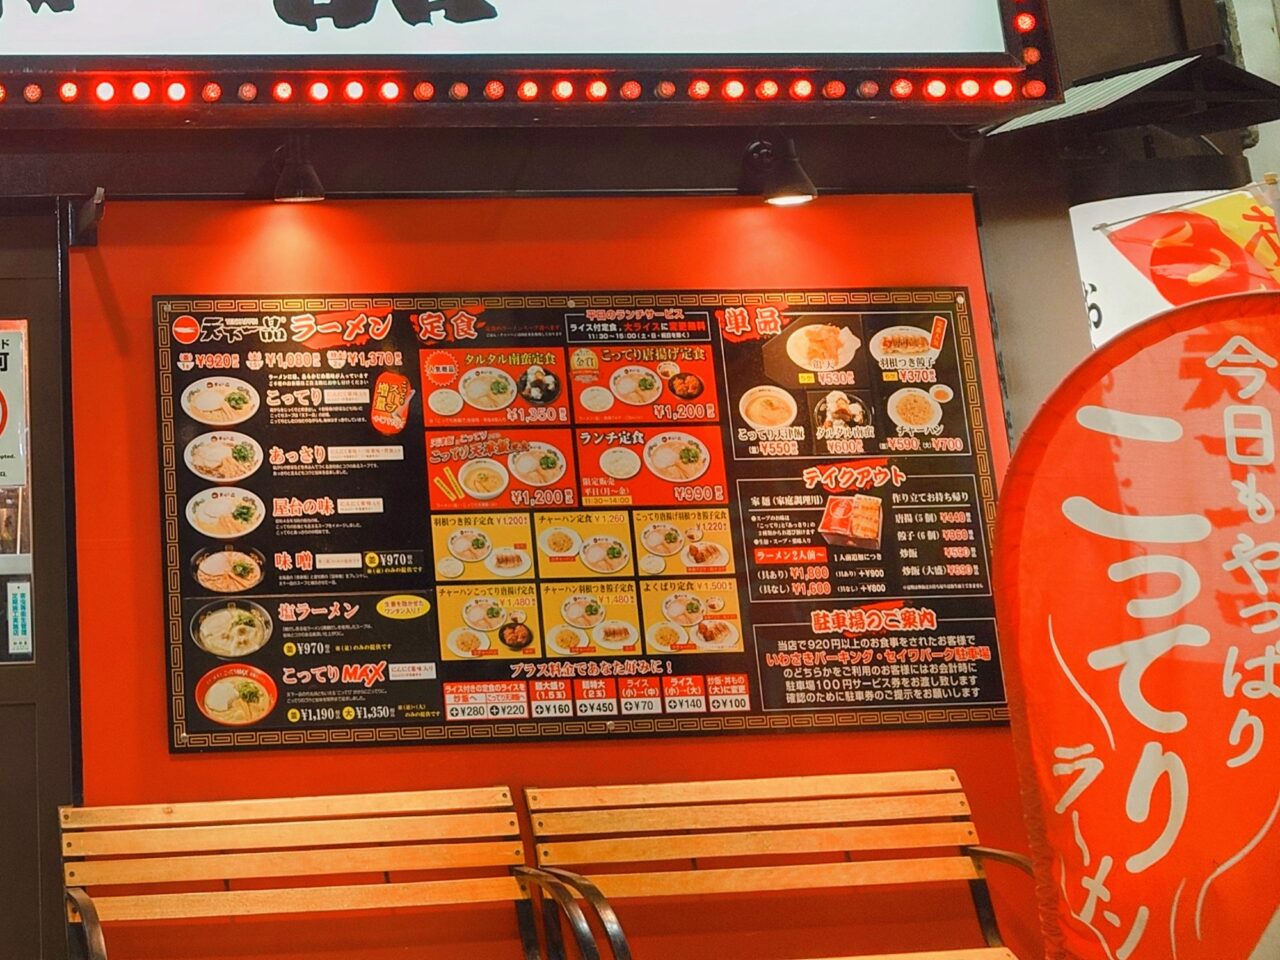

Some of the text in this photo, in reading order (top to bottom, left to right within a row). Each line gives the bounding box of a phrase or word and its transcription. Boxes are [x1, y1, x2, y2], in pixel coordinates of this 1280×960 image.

[200, 313, 392, 343] 天下一品 ラーメン
[419, 311, 478, 341] 定食
[724, 307, 782, 335] 単品
[195, 353, 230, 369] ¥920
[899, 369, 929, 383] ¥370
[266, 389, 322, 406] こってり
[580, 431, 645, 445] ランチ定食
[827, 440, 858, 453] ¥600
[269, 446, 326, 464] あっさり
[759, 441, 791, 455] ¥550
[802, 464, 907, 489] テイクアウト
[273, 497, 334, 516] 屋台の味
[380, 554, 406, 565] ¥970
[278, 601, 360, 621] 塩ラーメン
[811, 607, 937, 633] 駐車場のご案内
[1062, 405, 1212, 873] こってり
[297, 642, 324, 655] ¥970
[626, 679, 649, 689] ライス
[671, 677, 693, 687] ライス
[1052, 743, 1150, 960] ラーメン
